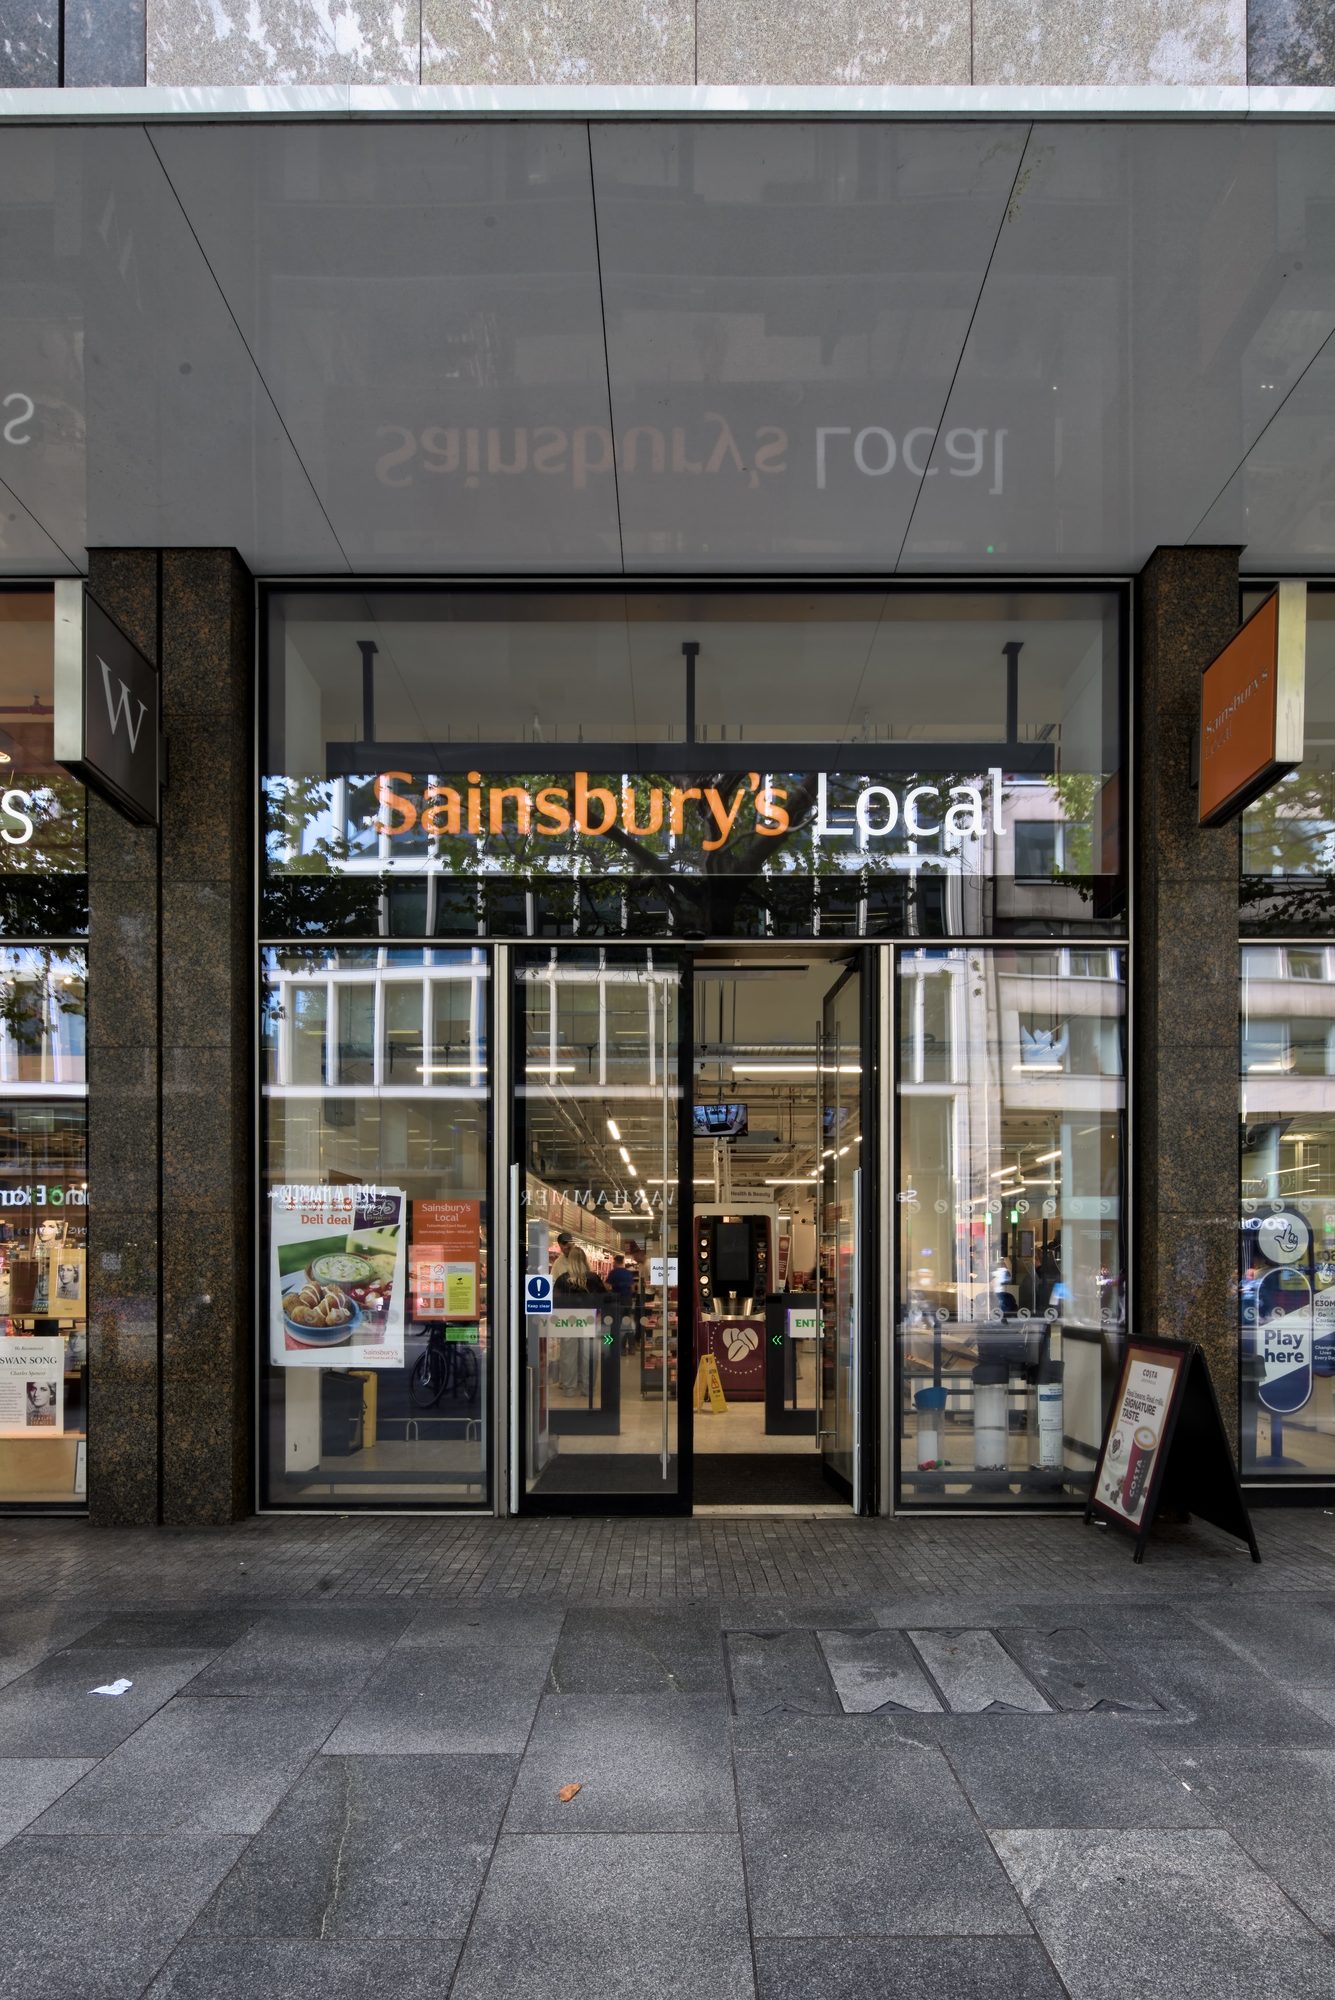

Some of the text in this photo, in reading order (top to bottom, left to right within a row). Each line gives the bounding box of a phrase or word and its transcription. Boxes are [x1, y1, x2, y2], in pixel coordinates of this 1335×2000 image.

[96, 654, 149, 755] W
[1205, 663, 1269, 736] Sainsbury's
[373, 766, 1008, 851] Sainsbury's Local
[422, 1203, 471, 1214] Sainsbury's
[301, 1214, 352, 1225] Deli deal
[435, 1213, 459, 1222] Local
[1264, 1329, 1305, 1350] Play
[0, 1357, 57, 1365] SWAN SONG
[1264, 1348, 1305, 1363] here
[1142, 1368, 1158, 1378] COSTA
[1124, 1397, 1157, 1416] SIGNATURE
[1129, 1459, 1143, 1497] COSTA
